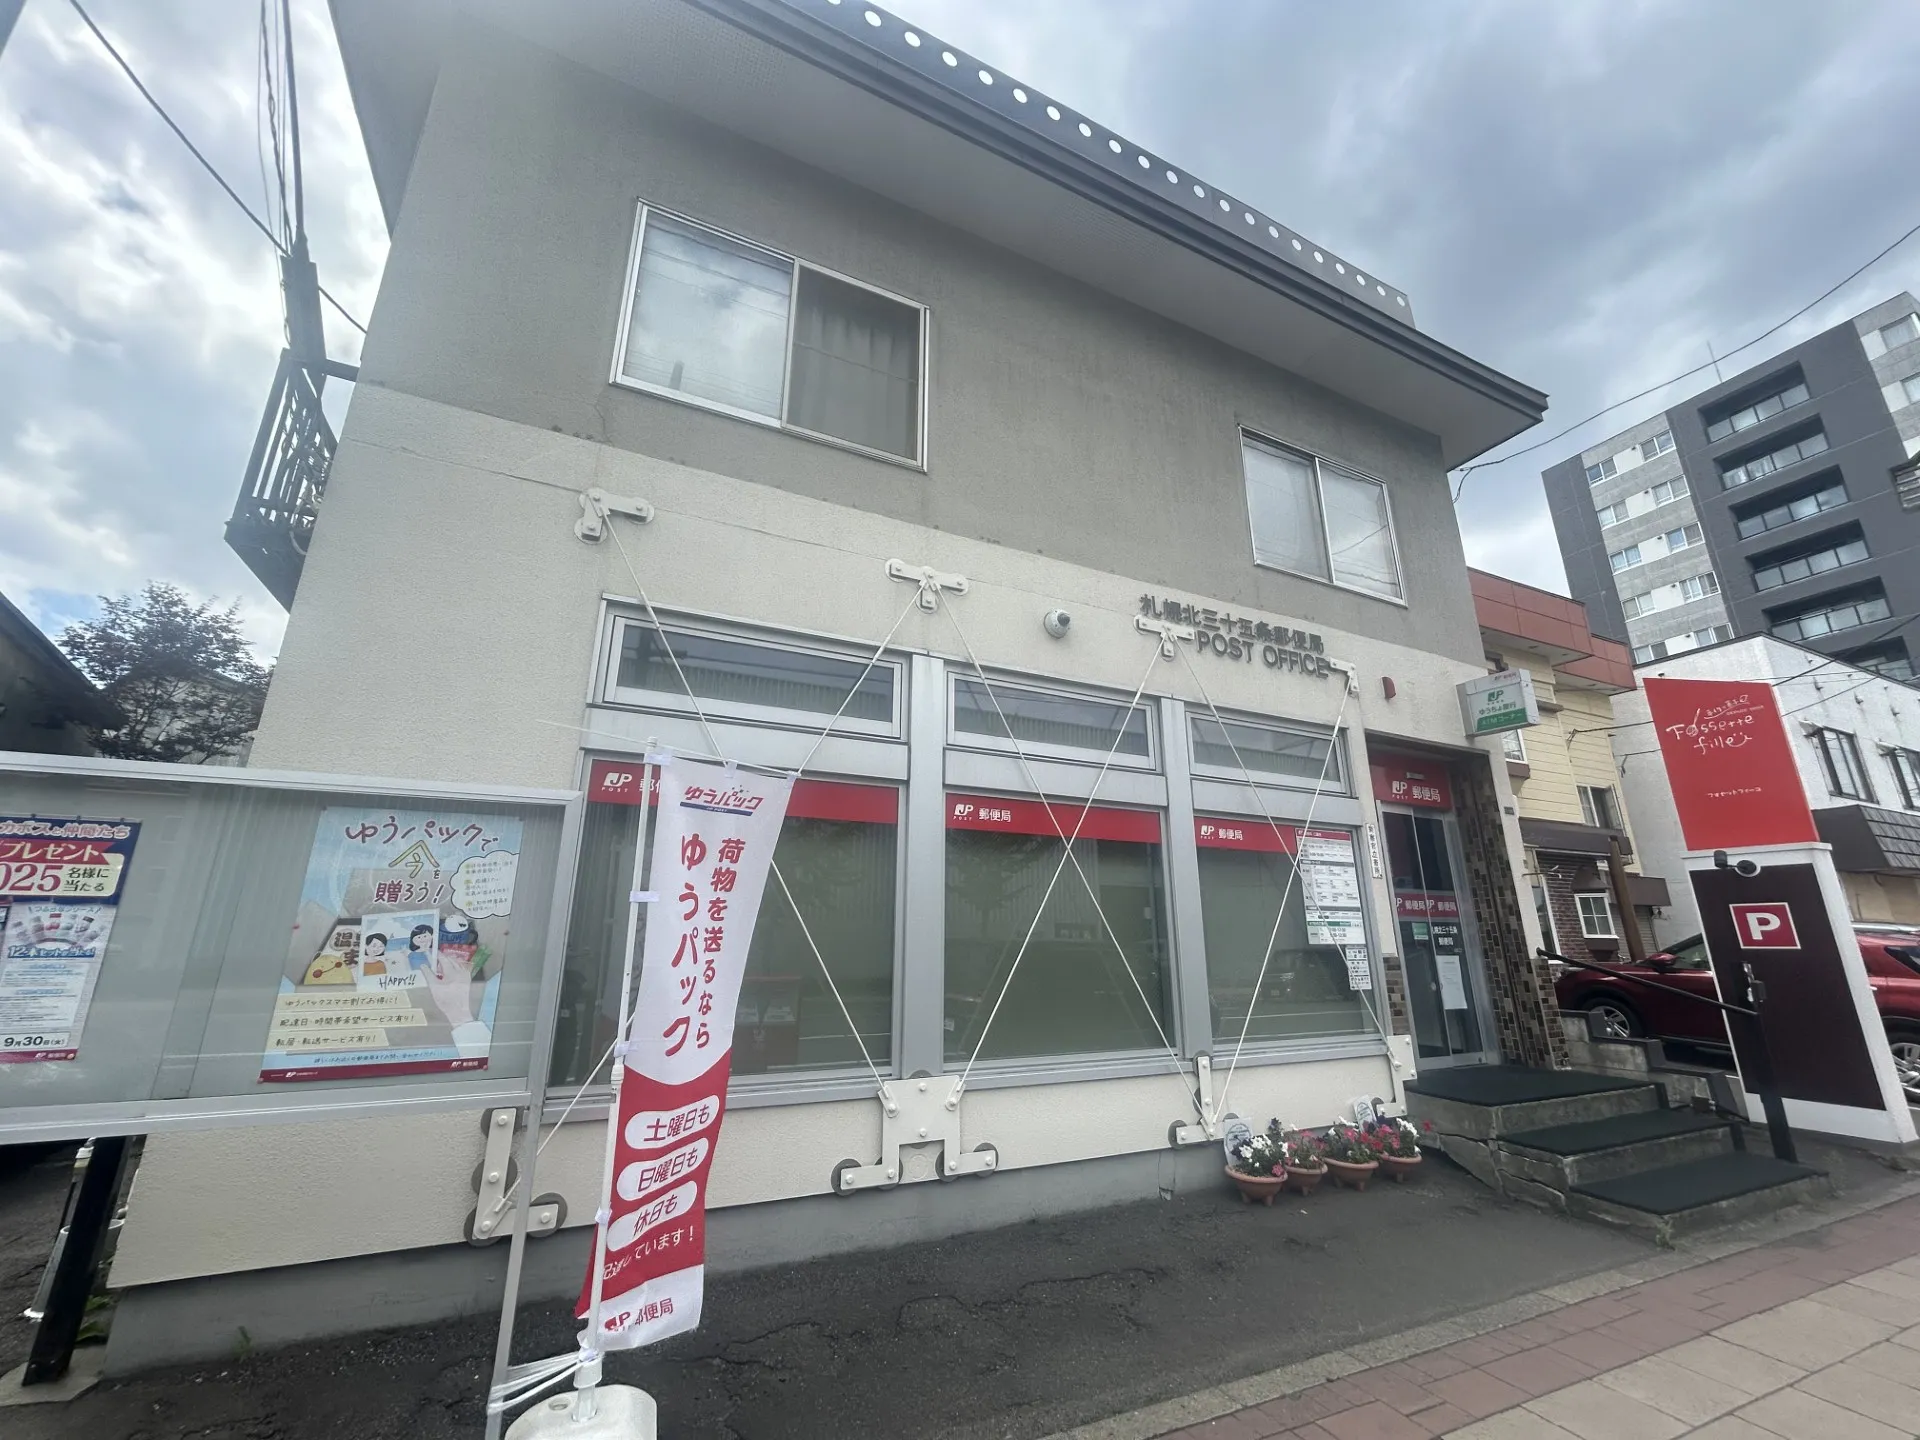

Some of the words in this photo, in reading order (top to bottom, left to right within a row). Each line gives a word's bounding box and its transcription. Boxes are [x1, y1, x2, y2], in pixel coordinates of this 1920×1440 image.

[1197, 630, 1254, 663] POST
[1263, 645, 1329, 680] OFFICE
[684, 786, 764, 810] ゆうパック
[1412, 785, 1441, 802] 郵便局
[978, 807, 1012, 822] 郵便局
[345, 816, 499, 851] ゆうパックで
[1218, 828, 1243, 841] 郵便局
[63, 880, 105, 892] 当たる
[67, 867, 110, 879] 名様に
[1746, 913, 1780, 940] P
[662, 833, 707, 1057] ゆうパック
[695, 838, 746, 1049] 荷物を送るなら
[379, 974, 416, 990] HAPPY!!
[644, 1104, 710, 1142] 土曜日も
[637, 1147, 698, 1193] 日曜日も
[633, 1194, 678, 1237] 休日も
